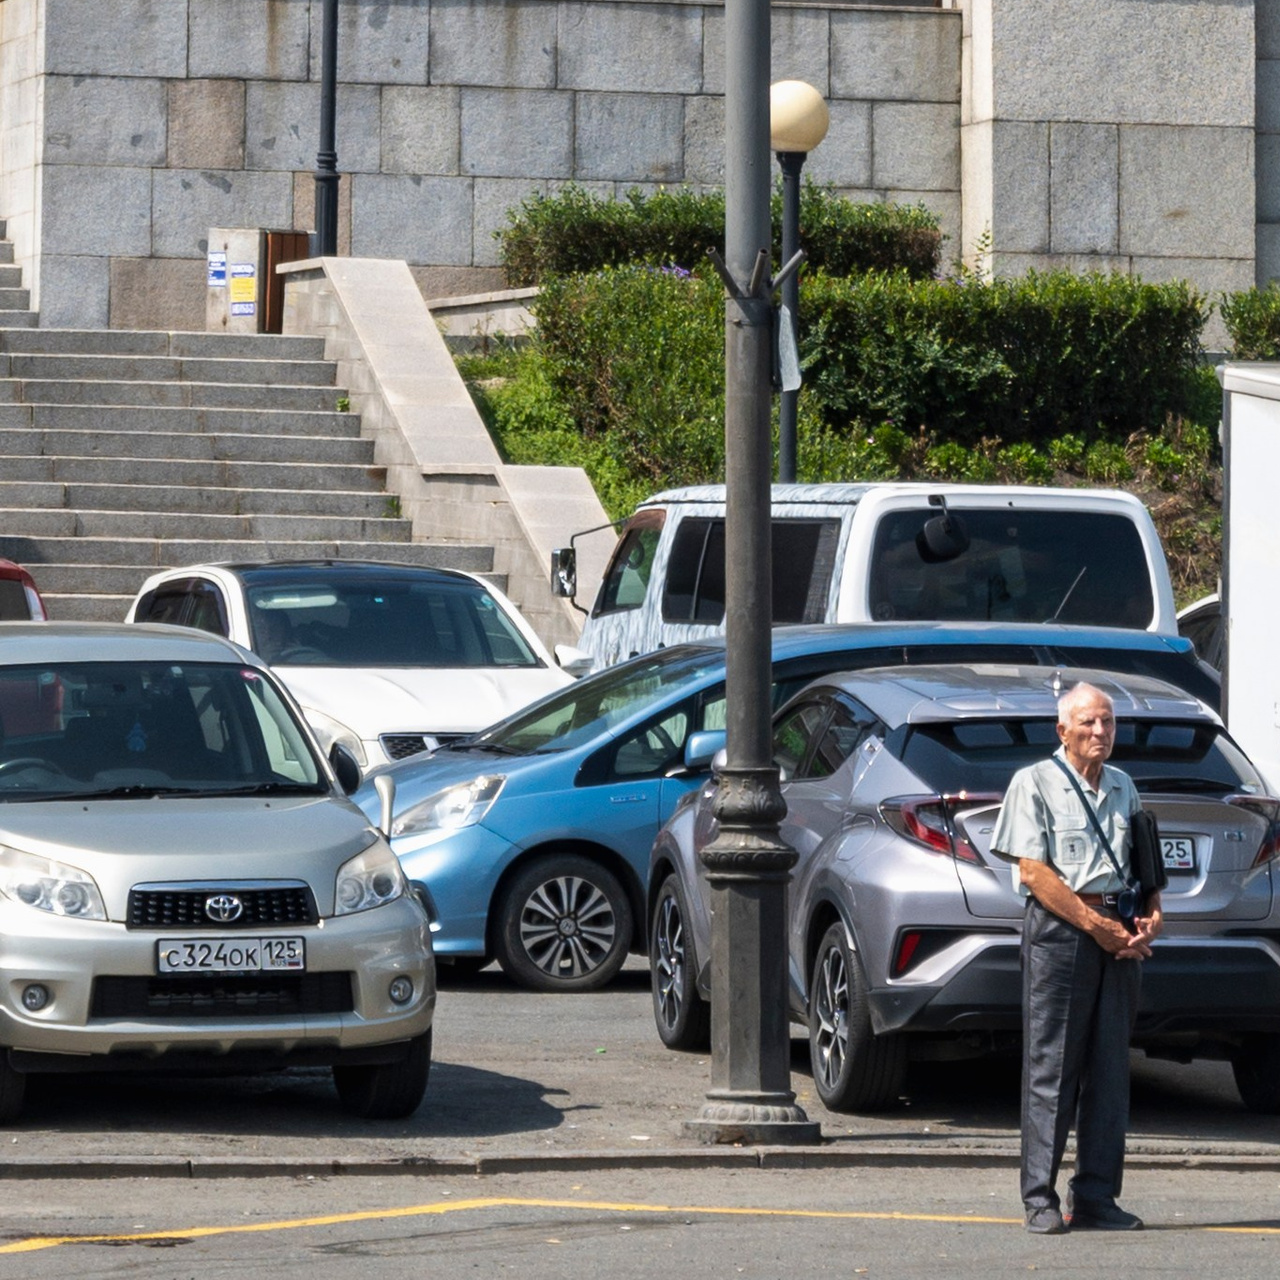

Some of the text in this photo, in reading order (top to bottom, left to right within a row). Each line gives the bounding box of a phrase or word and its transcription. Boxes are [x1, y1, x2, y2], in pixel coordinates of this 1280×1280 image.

[1163, 841, 1187, 859] 25
[166, 940, 297, 968] С324ОК 125
